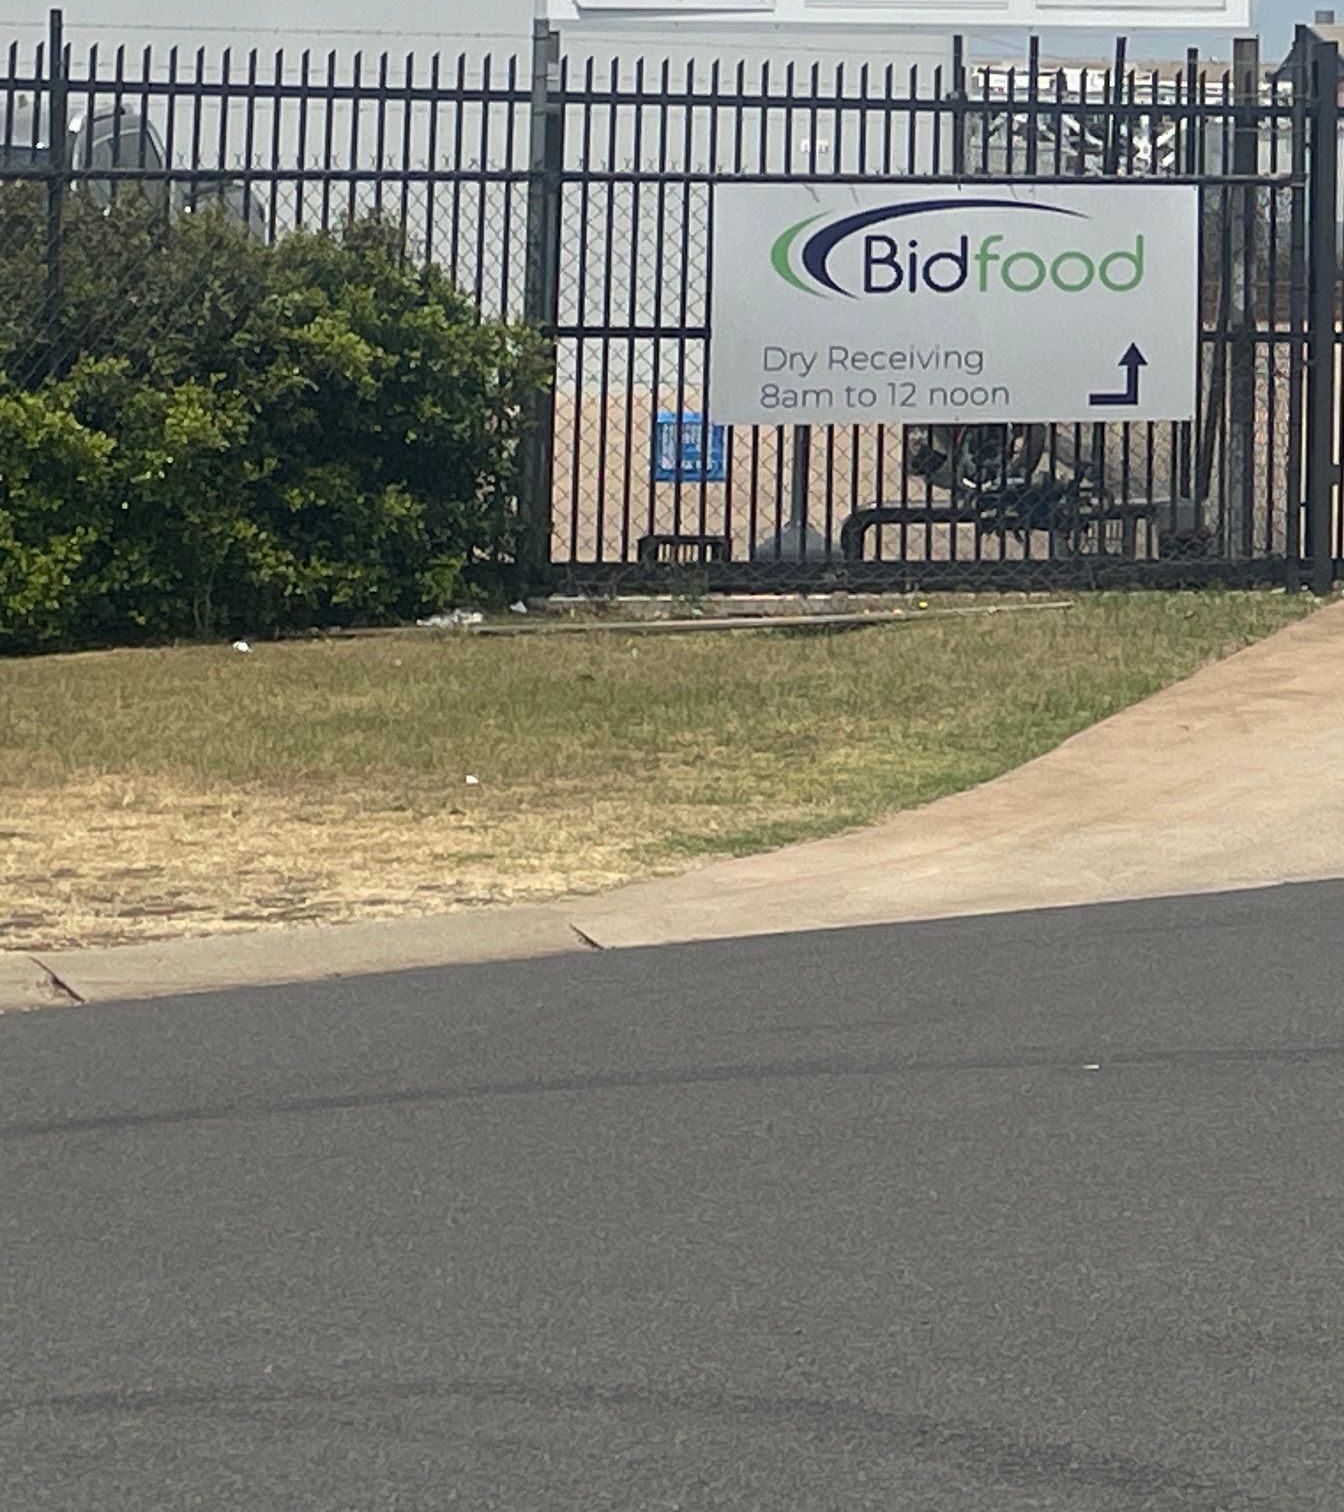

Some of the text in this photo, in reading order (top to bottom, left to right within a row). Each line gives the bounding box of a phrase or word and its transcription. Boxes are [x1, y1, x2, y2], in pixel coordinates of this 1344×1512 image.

[863, 234, 1144, 294] Bidfood
[763, 345, 983, 377] Dry Receiving
[760, 383, 1010, 409] 8am to 12 noon
